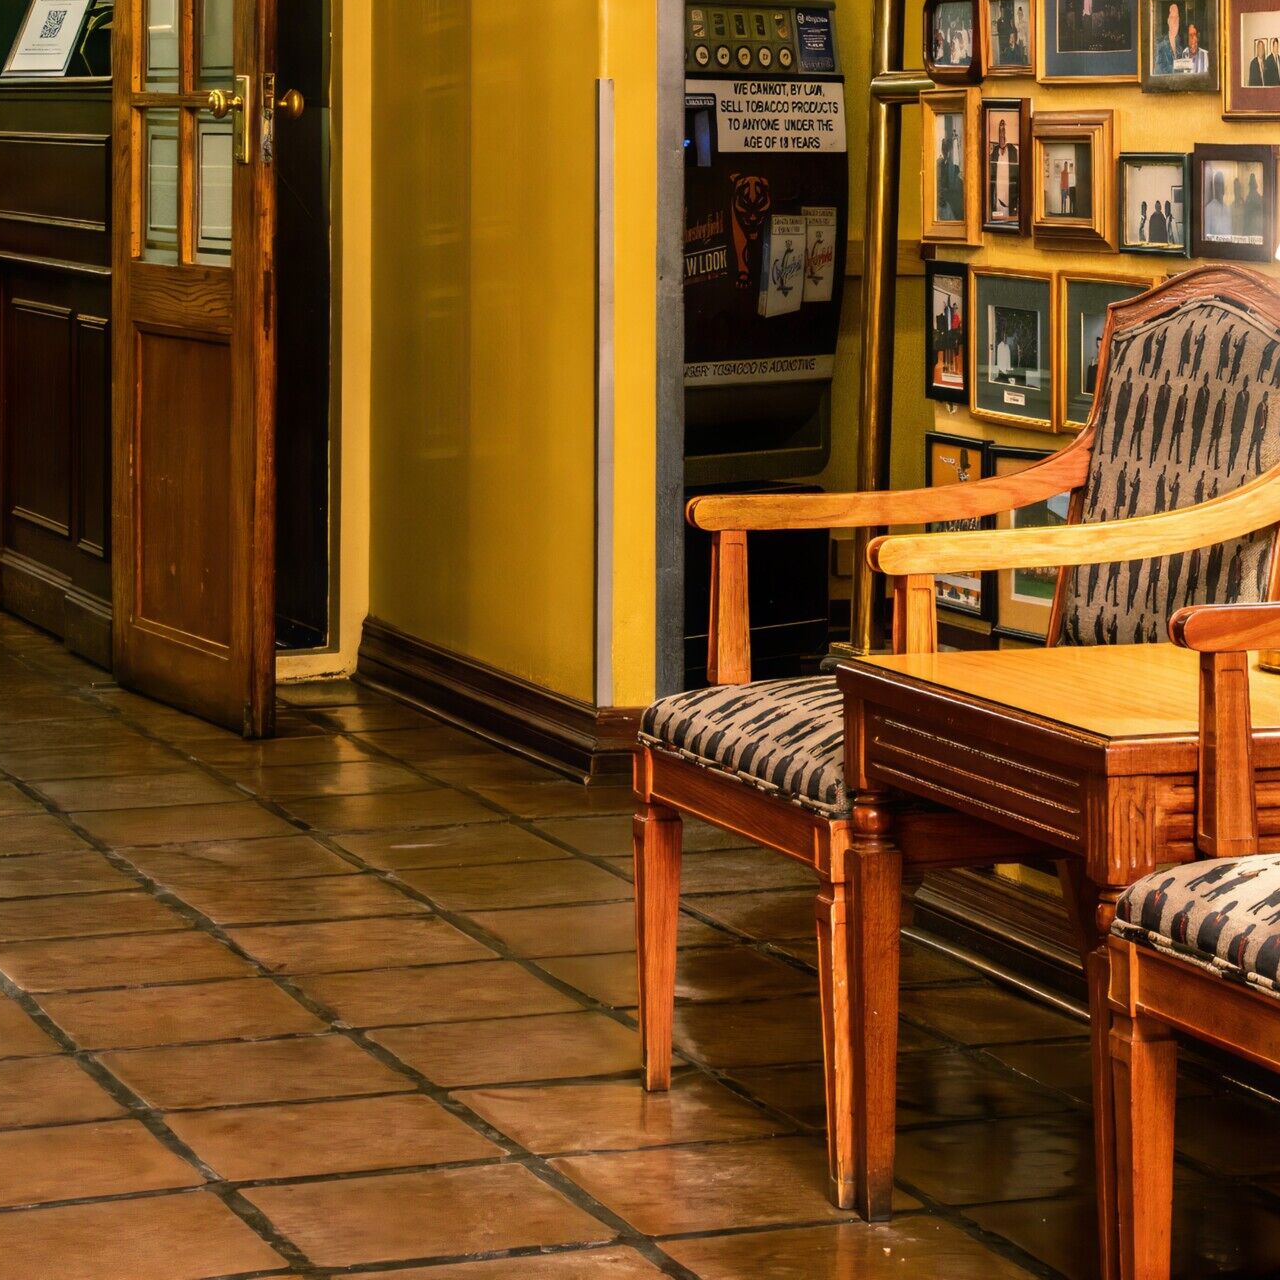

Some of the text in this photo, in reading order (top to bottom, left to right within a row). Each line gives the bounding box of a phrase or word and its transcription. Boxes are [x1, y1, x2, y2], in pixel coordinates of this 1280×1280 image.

[733, 83, 748, 95] WE
[791, 84, 801, 96] BY
[721, 101, 743, 112] SELL
[746, 101, 789, 113] TOBACCO
[792, 102, 839, 114] PRODUCTS
[728, 118, 834, 131] TO ANYONE UNDER THE
[744, 136, 762, 148] AGE
[765, 136, 777, 148] OF
[791, 136, 821, 148] YEARS
[700, 249, 727, 273] LOOK
